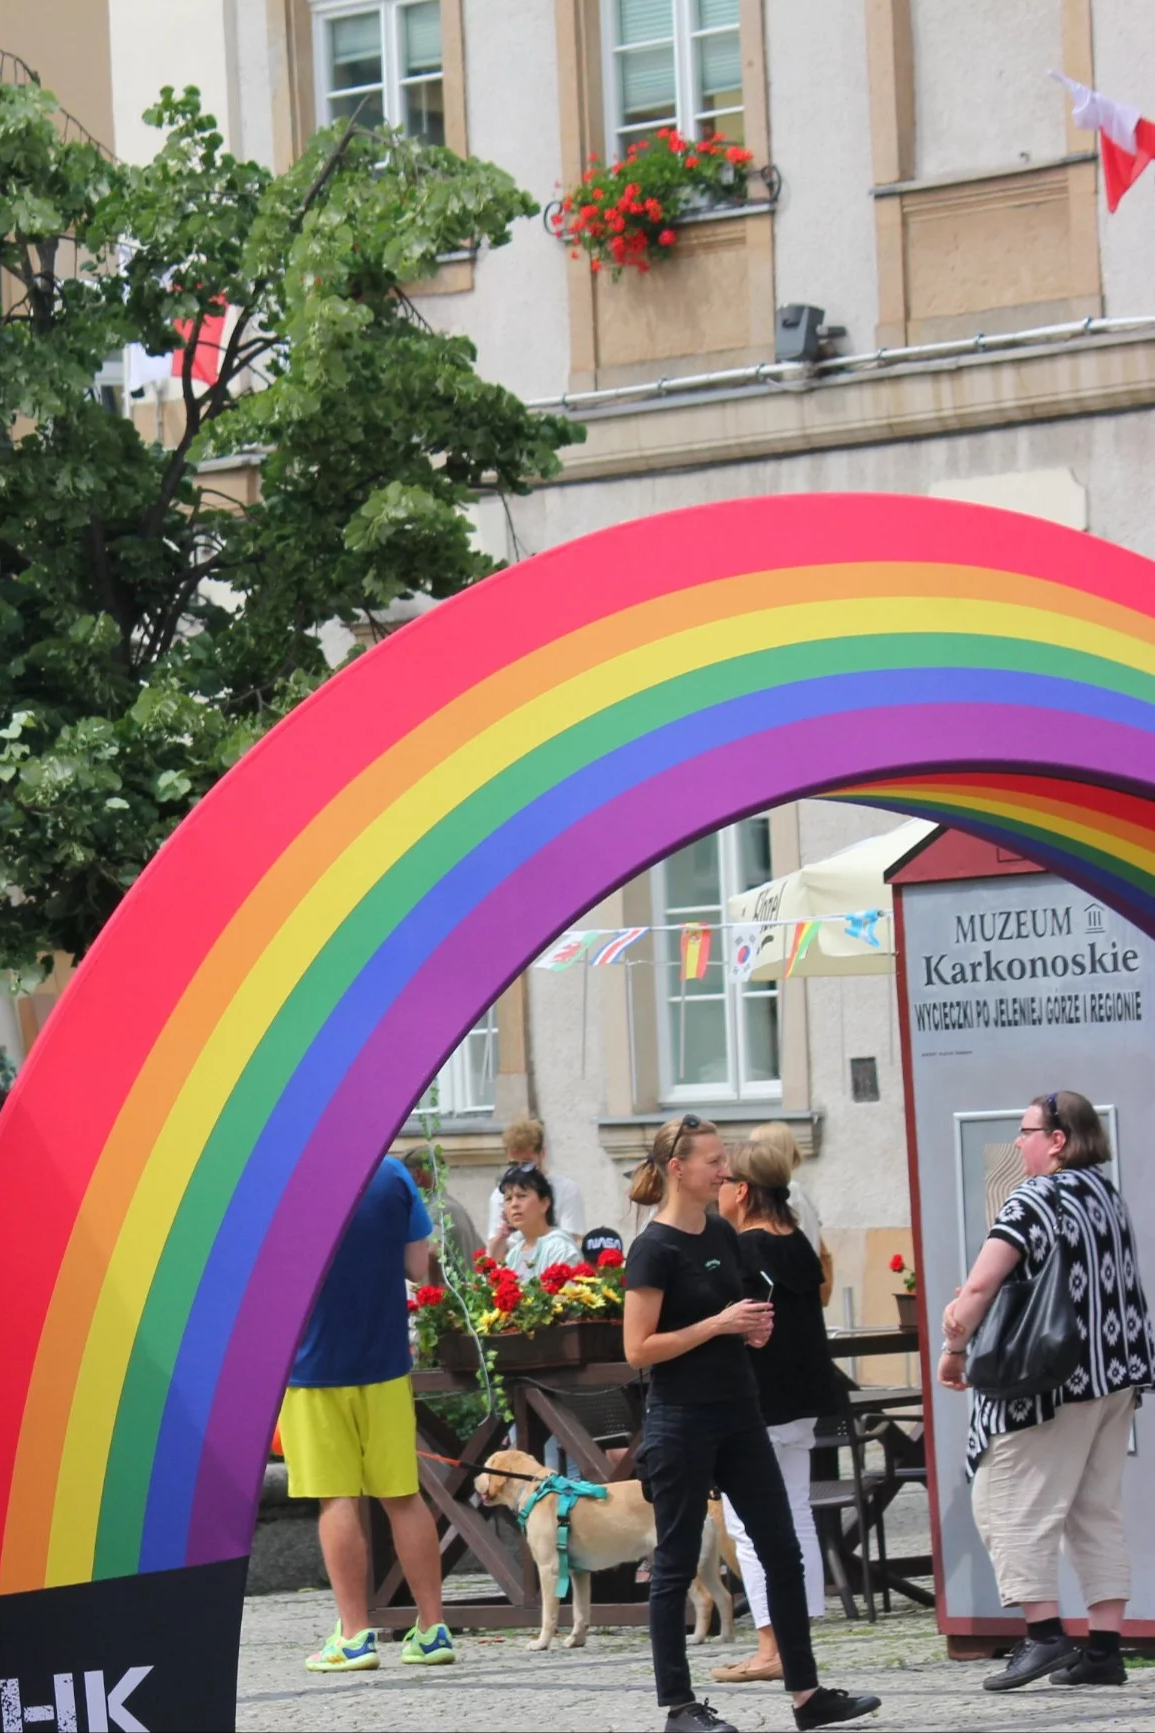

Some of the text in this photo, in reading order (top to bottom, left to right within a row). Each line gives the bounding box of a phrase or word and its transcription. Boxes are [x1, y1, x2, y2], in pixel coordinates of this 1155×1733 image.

[955, 906, 1073, 945] MUZEUM
[923, 941, 1140, 987] Karkonoskie
[914, 999, 976, 1032] WYCIECZKI
[977, 999, 990, 1028] PO
[993, 996, 1043, 1028] JELENIEJ
[1090, 991, 1142, 1023] REGIONIE
[586, 1236, 622, 1251] NASA
[0, 1665, 155, 1733] HK
